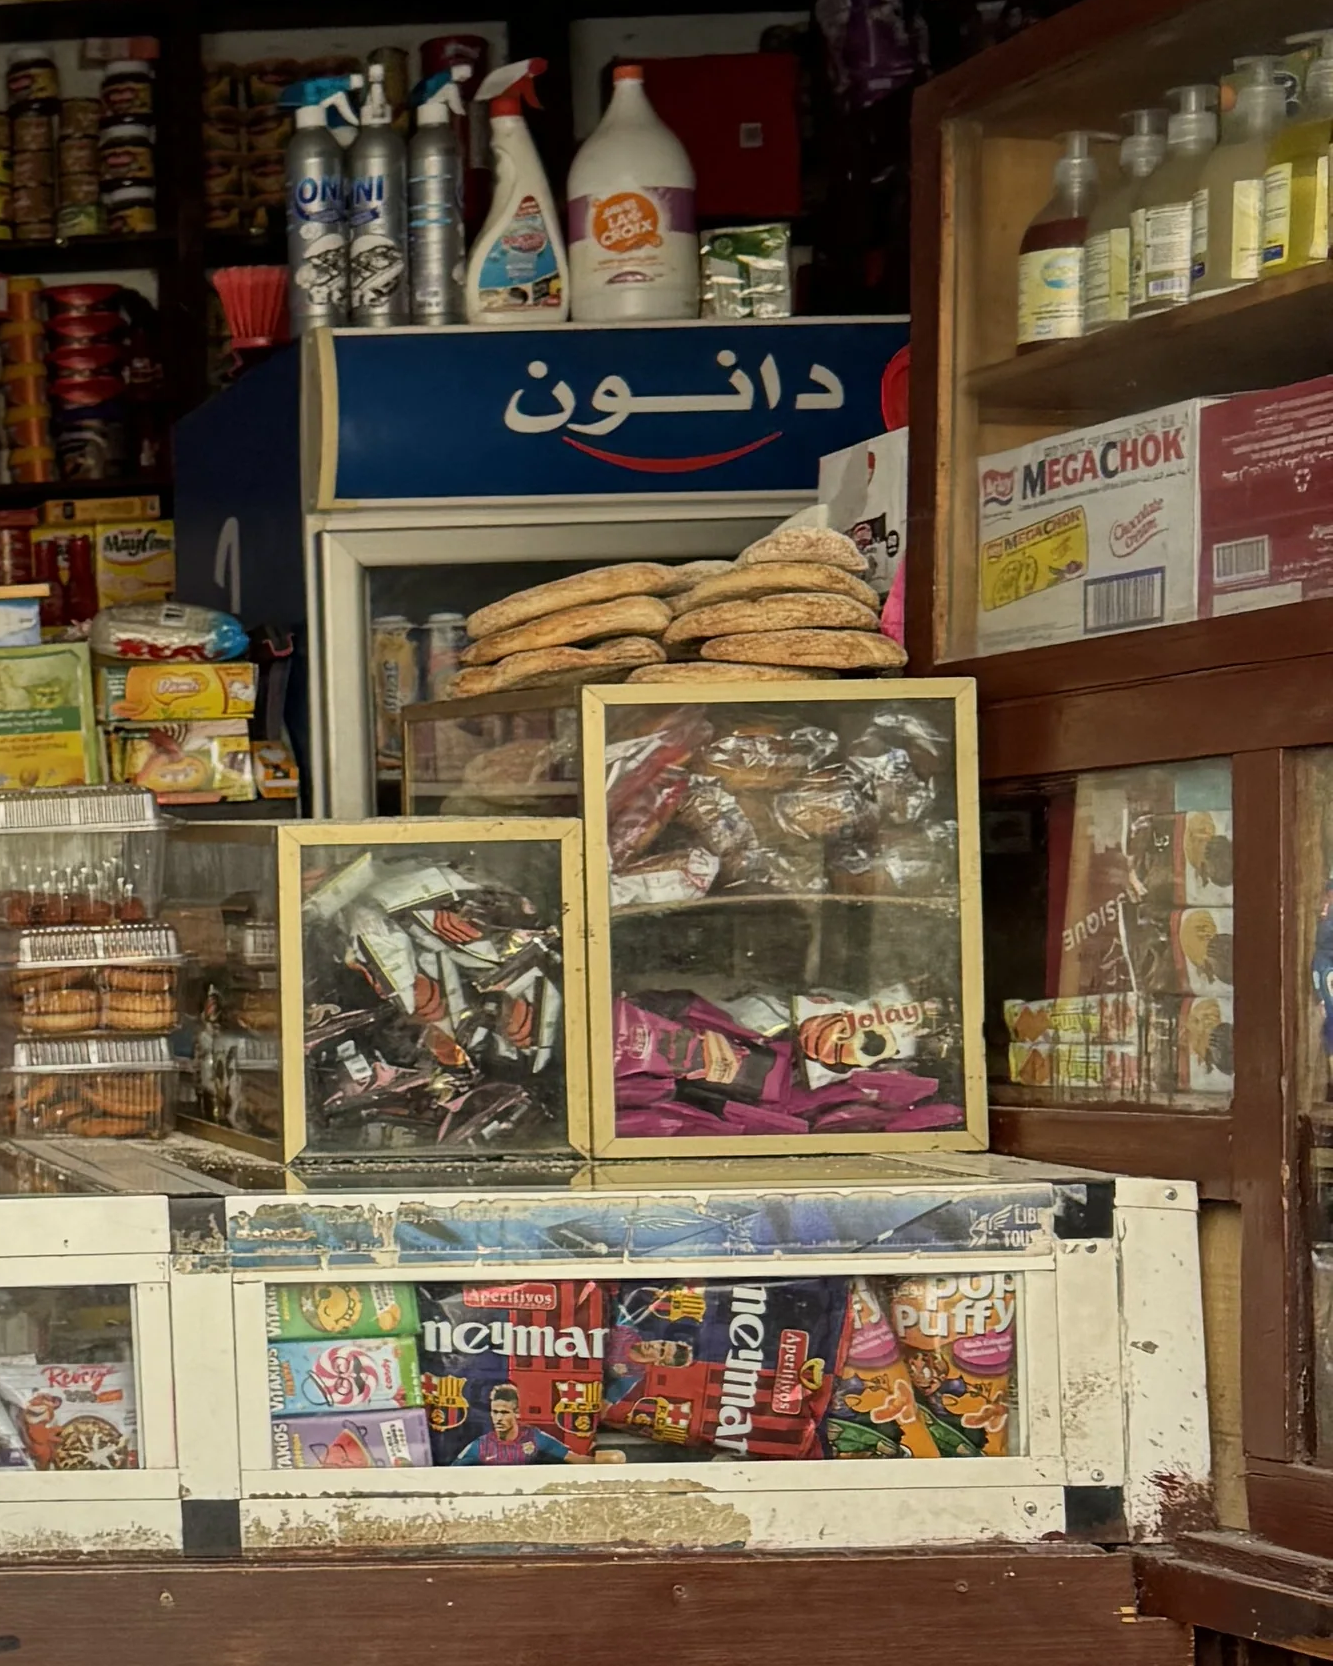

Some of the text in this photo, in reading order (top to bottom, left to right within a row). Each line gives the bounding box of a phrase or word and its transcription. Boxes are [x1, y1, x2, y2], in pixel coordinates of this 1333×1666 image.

[600, 218, 654, 246] CROIX
[502, 349, 846, 436] دانون
[1021, 427, 1185, 501] MEGACHOK
[1014, 1205, 1040, 1224] LIB
[468, 1288, 553, 1306] Aperitivos
[421, 1318, 611, 1359] neymar
[894, 1298, 1016, 1338] Puffy
[715, 1283, 768, 1457] neymar
[779, 1332, 802, 1410] Aperitivos
